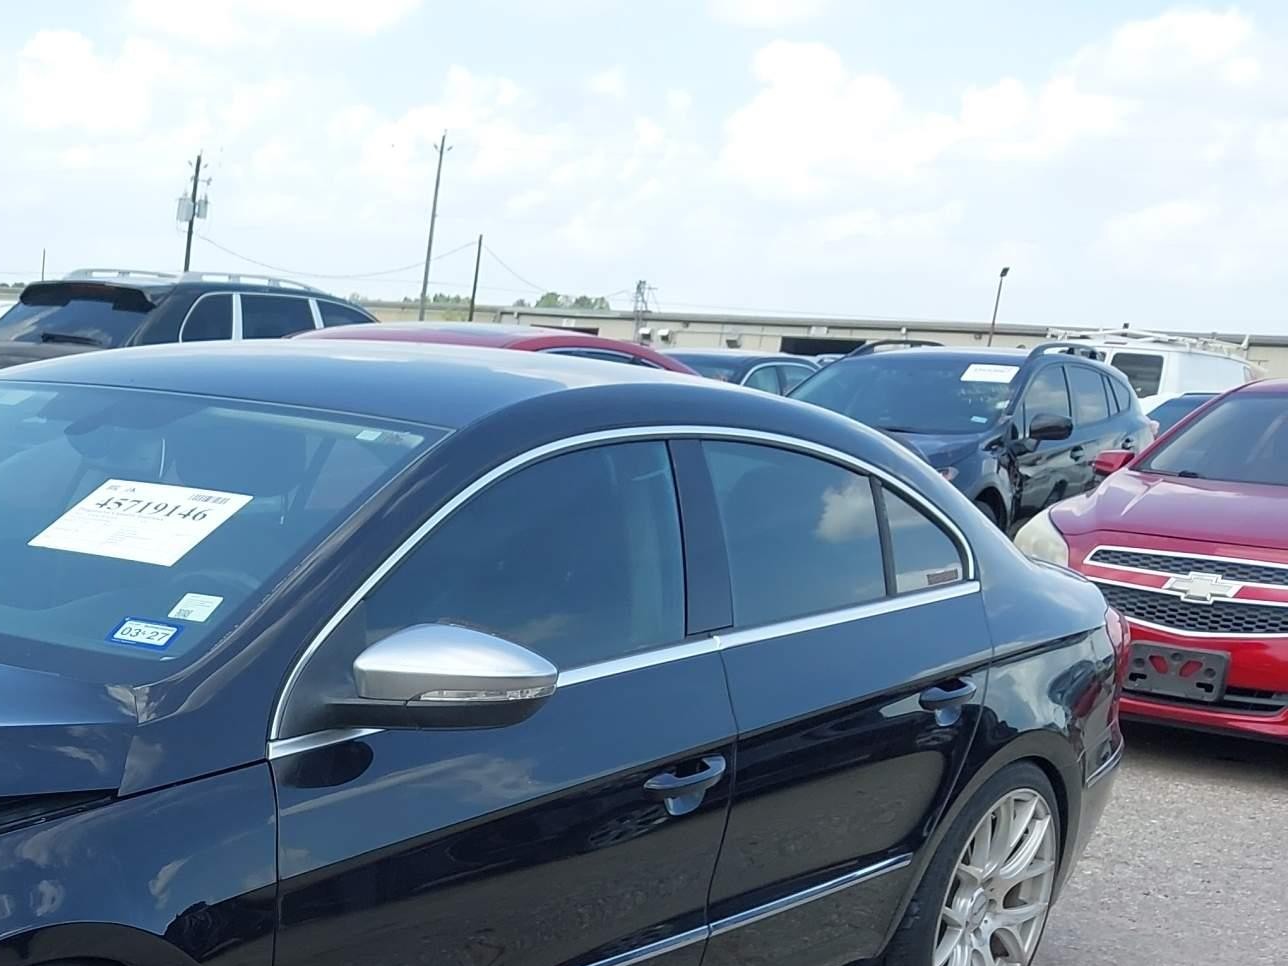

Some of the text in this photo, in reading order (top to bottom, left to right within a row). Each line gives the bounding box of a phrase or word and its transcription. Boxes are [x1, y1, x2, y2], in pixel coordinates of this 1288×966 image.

[95, 496, 213, 522] 45719146
[120, 626, 142, 638] 03
[146, 630, 169, 642] 27
